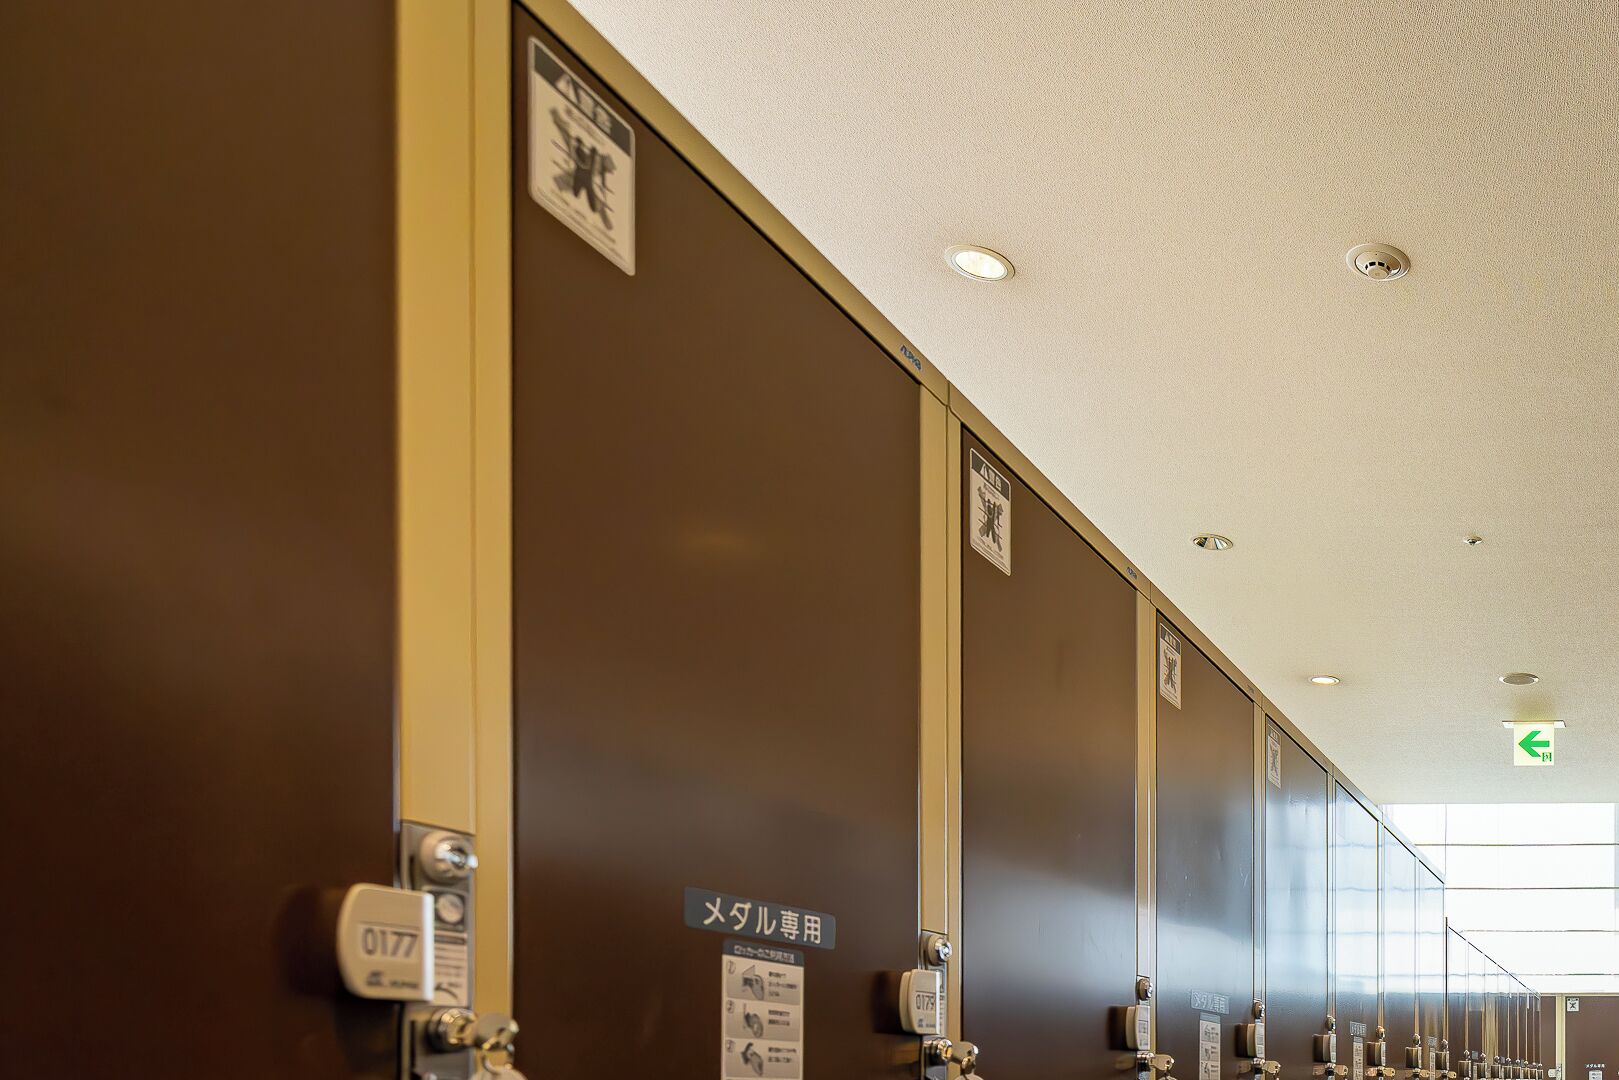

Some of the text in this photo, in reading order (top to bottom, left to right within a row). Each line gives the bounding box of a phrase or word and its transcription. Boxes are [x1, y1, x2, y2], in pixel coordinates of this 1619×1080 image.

[703, 897, 822, 944] メダル専用
[361, 928, 419, 958] 0177
